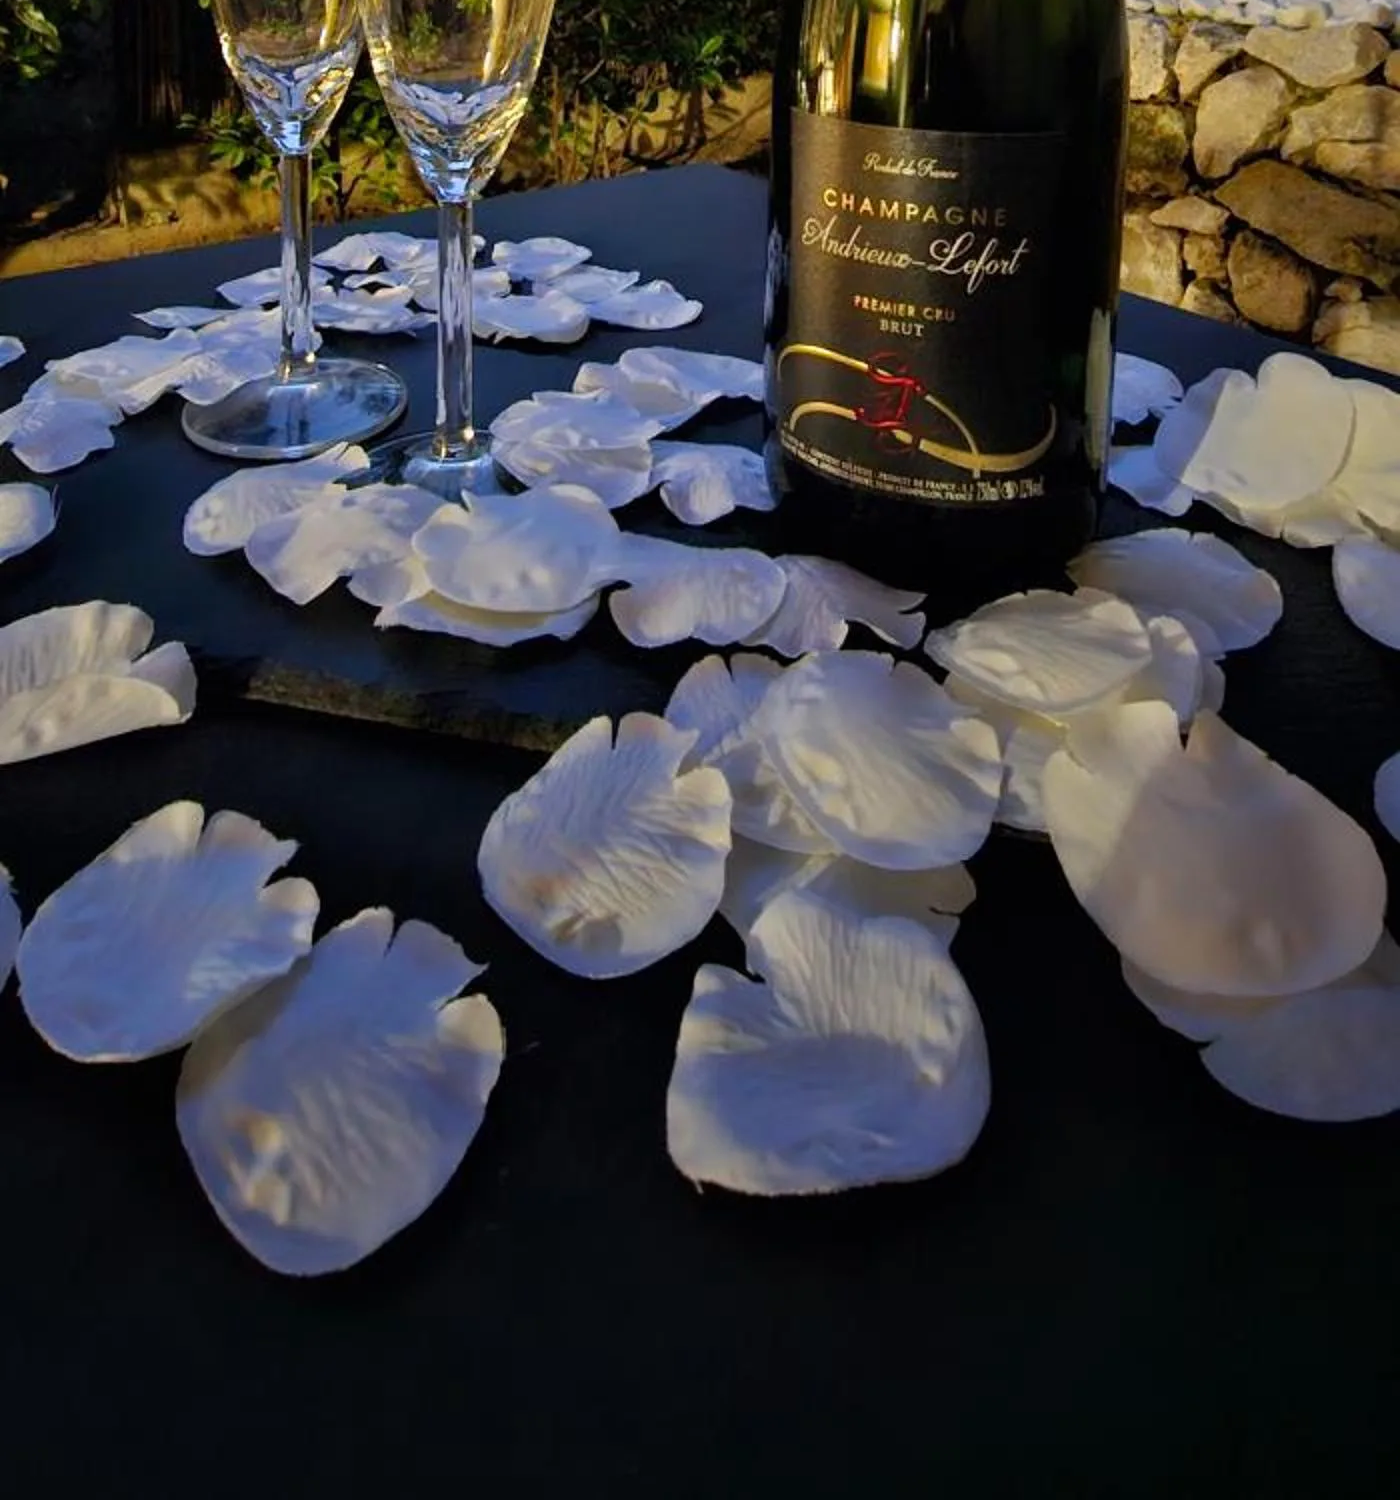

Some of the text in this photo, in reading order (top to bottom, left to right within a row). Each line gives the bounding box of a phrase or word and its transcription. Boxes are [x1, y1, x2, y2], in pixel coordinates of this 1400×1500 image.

[823, 188, 1008, 227] CHAMPAGNE
[853, 295, 956, 322] PREMIER CRU
[880, 318, 925, 337] BRUT
